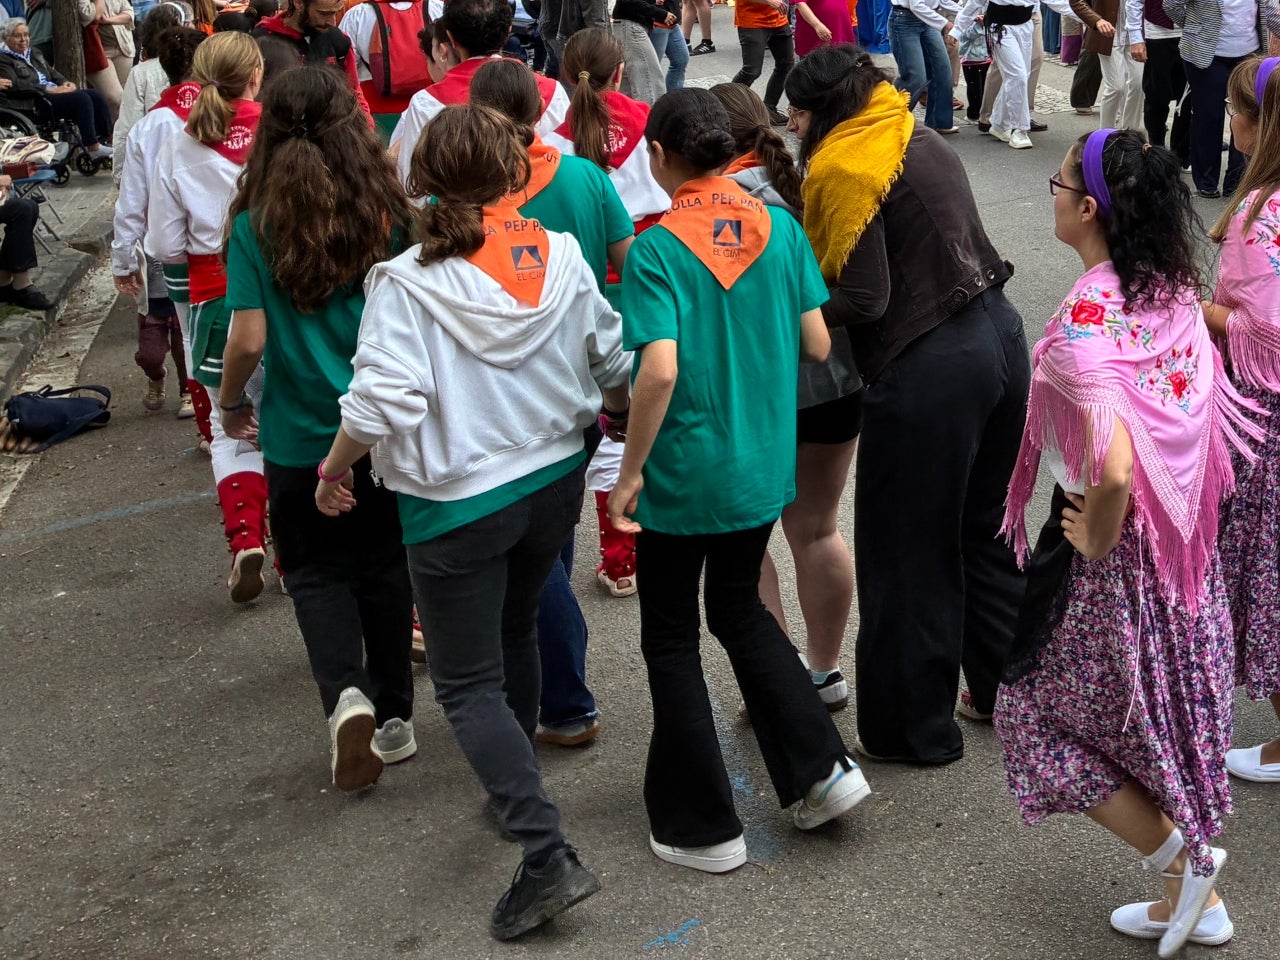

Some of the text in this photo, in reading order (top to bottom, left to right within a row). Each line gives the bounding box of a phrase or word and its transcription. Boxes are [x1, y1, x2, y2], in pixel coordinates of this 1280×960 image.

[712, 193, 735, 205] PEP
[504, 220, 528, 232] PEP
[516, 273, 528, 281] EL
